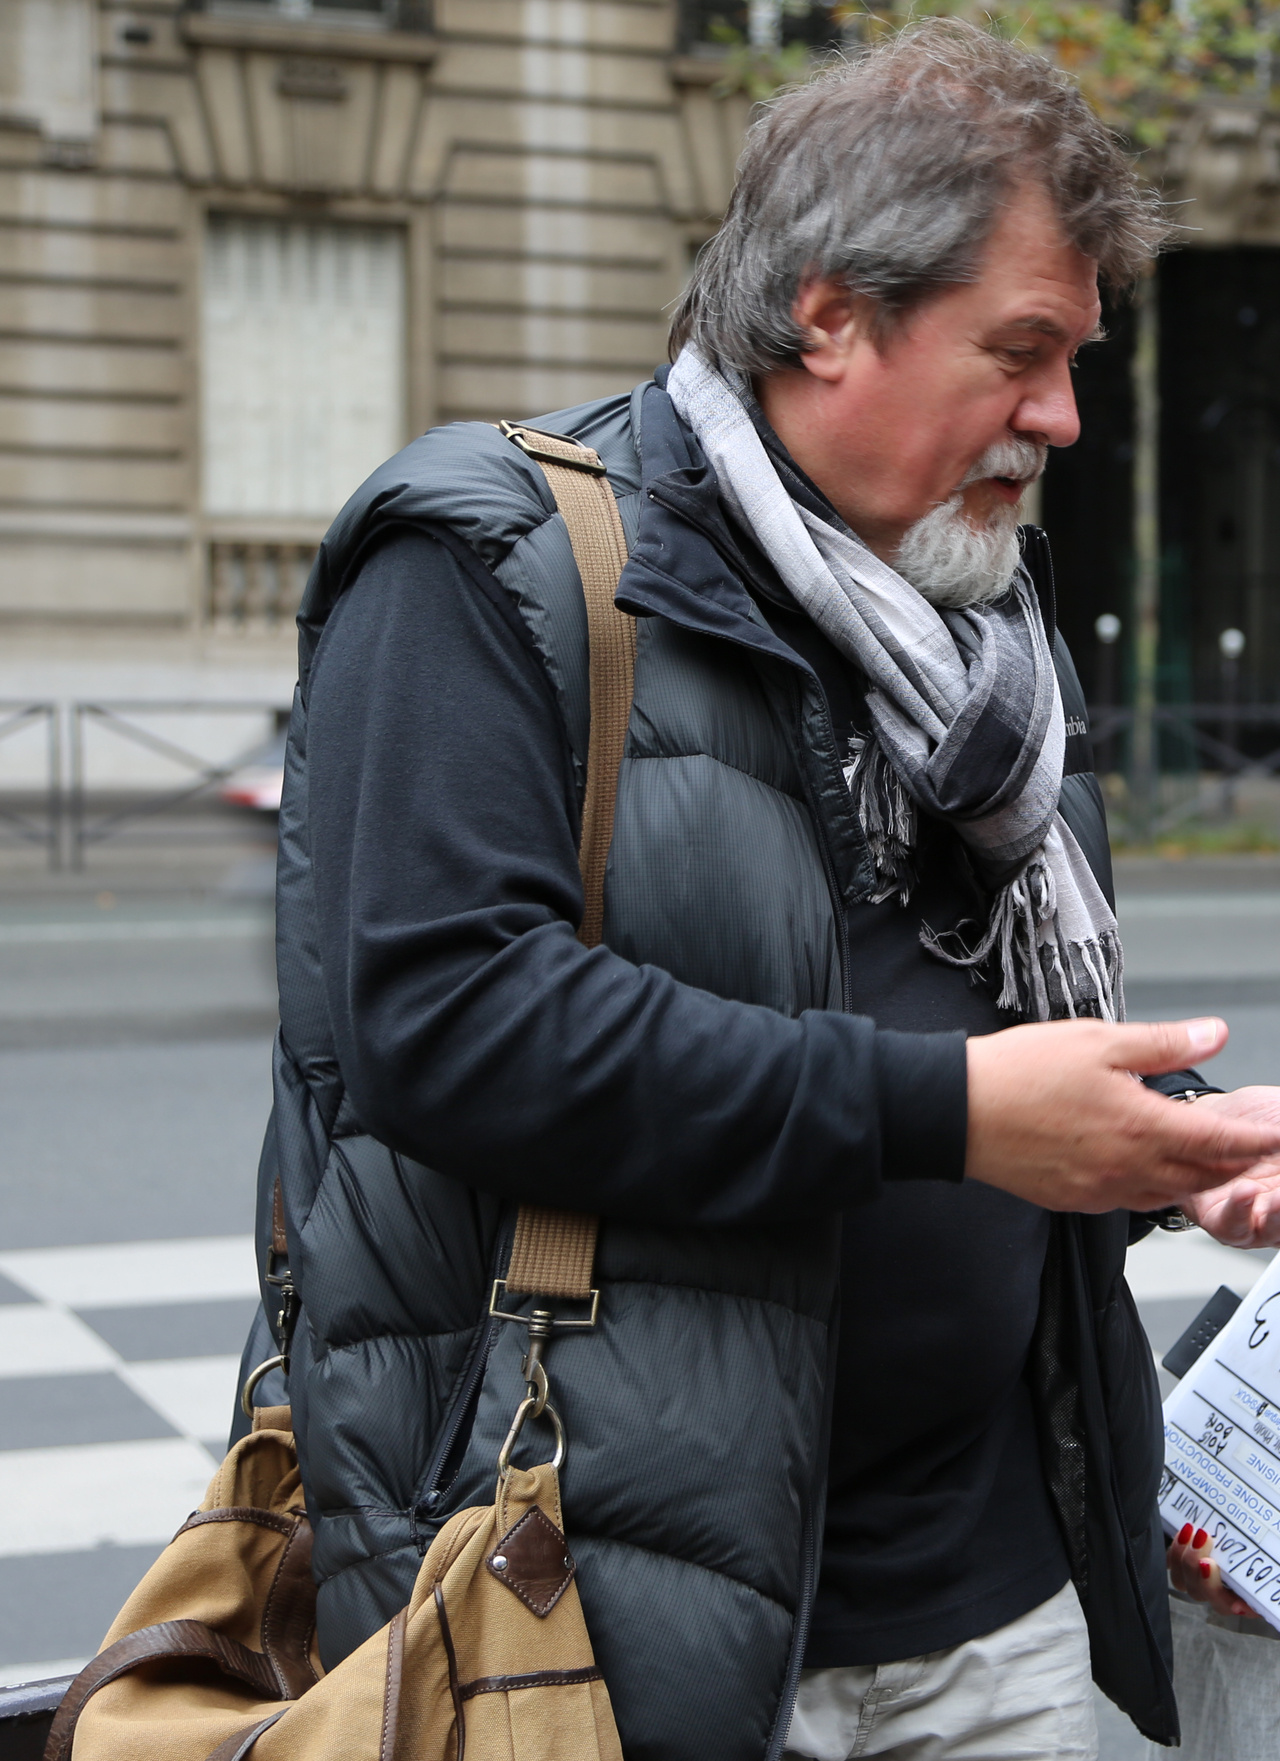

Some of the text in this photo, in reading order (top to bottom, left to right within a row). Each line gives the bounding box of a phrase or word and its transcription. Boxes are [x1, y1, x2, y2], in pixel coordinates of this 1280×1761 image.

[1253, 1421, 1274, 1444] Photo
[1162, 1425, 1233, 1488] PRODUCTION
[1169, 1458, 1226, 1505] COMPANY
[1171, 1492, 1199, 1523] NUIT
[1226, 1502, 1260, 1534] FLUID
[1231, 1483, 1272, 1521] STONE
